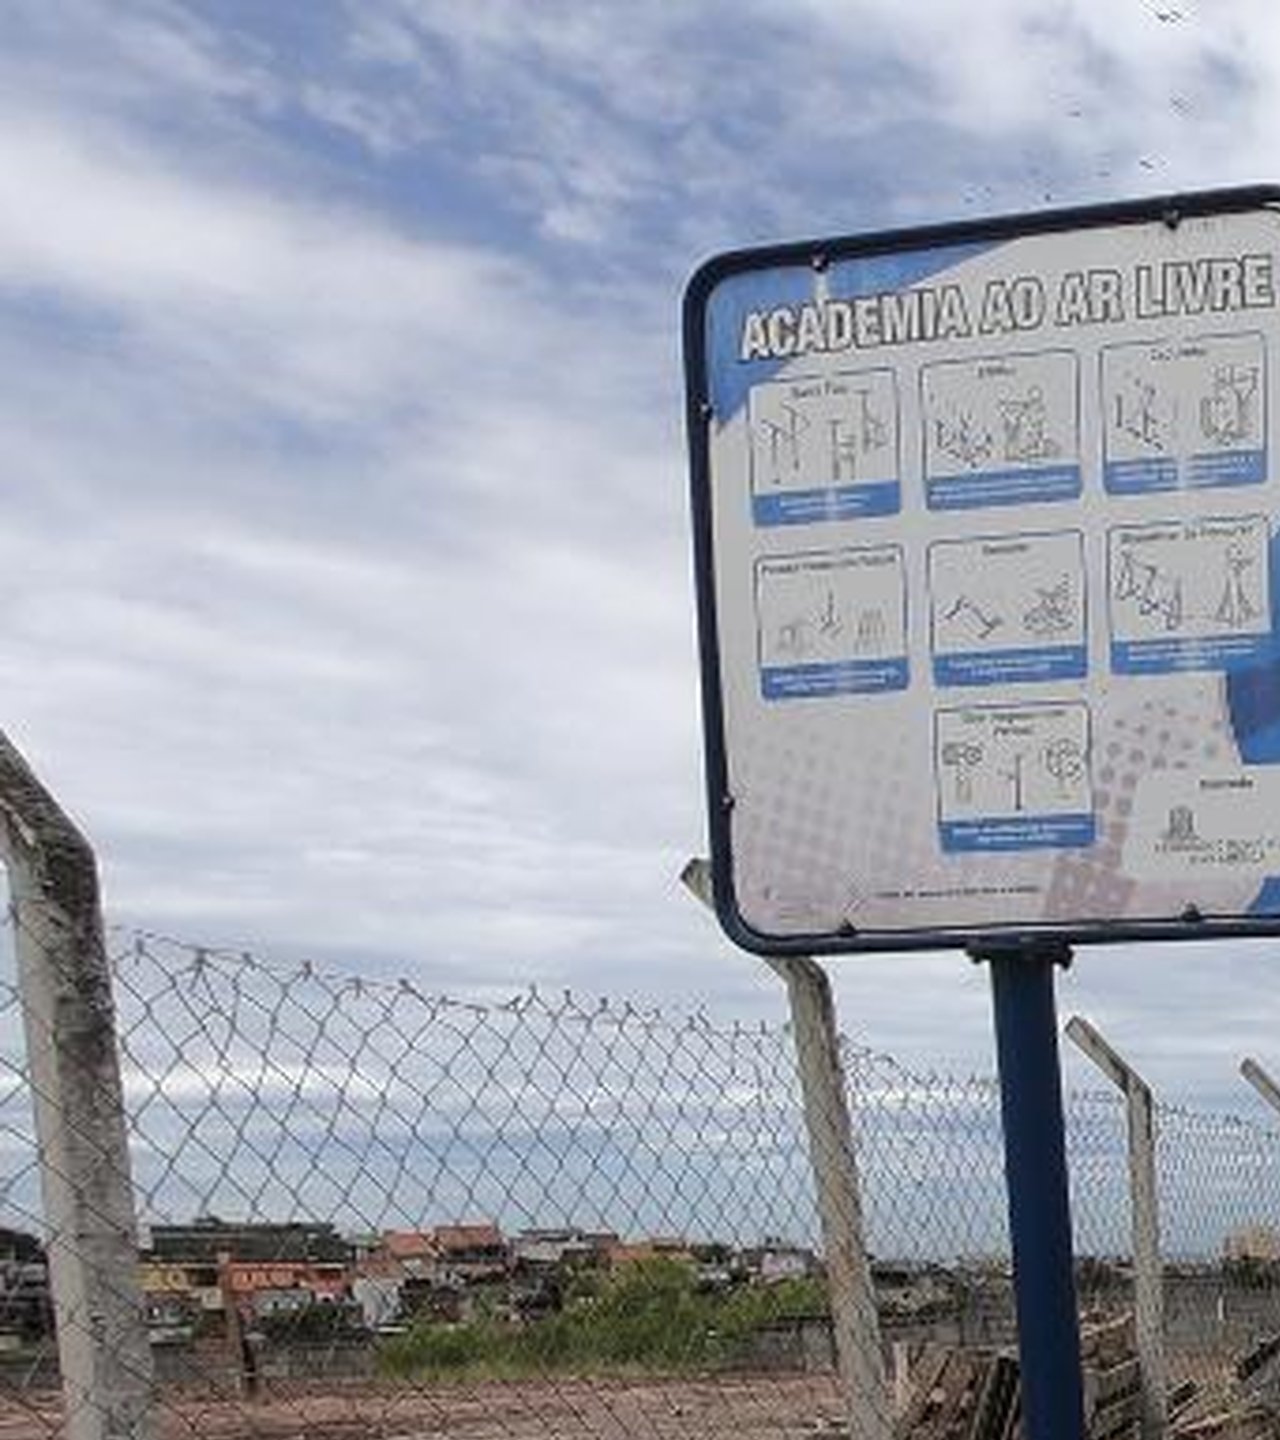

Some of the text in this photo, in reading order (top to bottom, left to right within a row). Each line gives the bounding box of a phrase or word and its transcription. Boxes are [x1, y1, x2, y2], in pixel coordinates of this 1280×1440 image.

[740, 253, 1276, 361] ACADEMIA AO AR LIVRE
